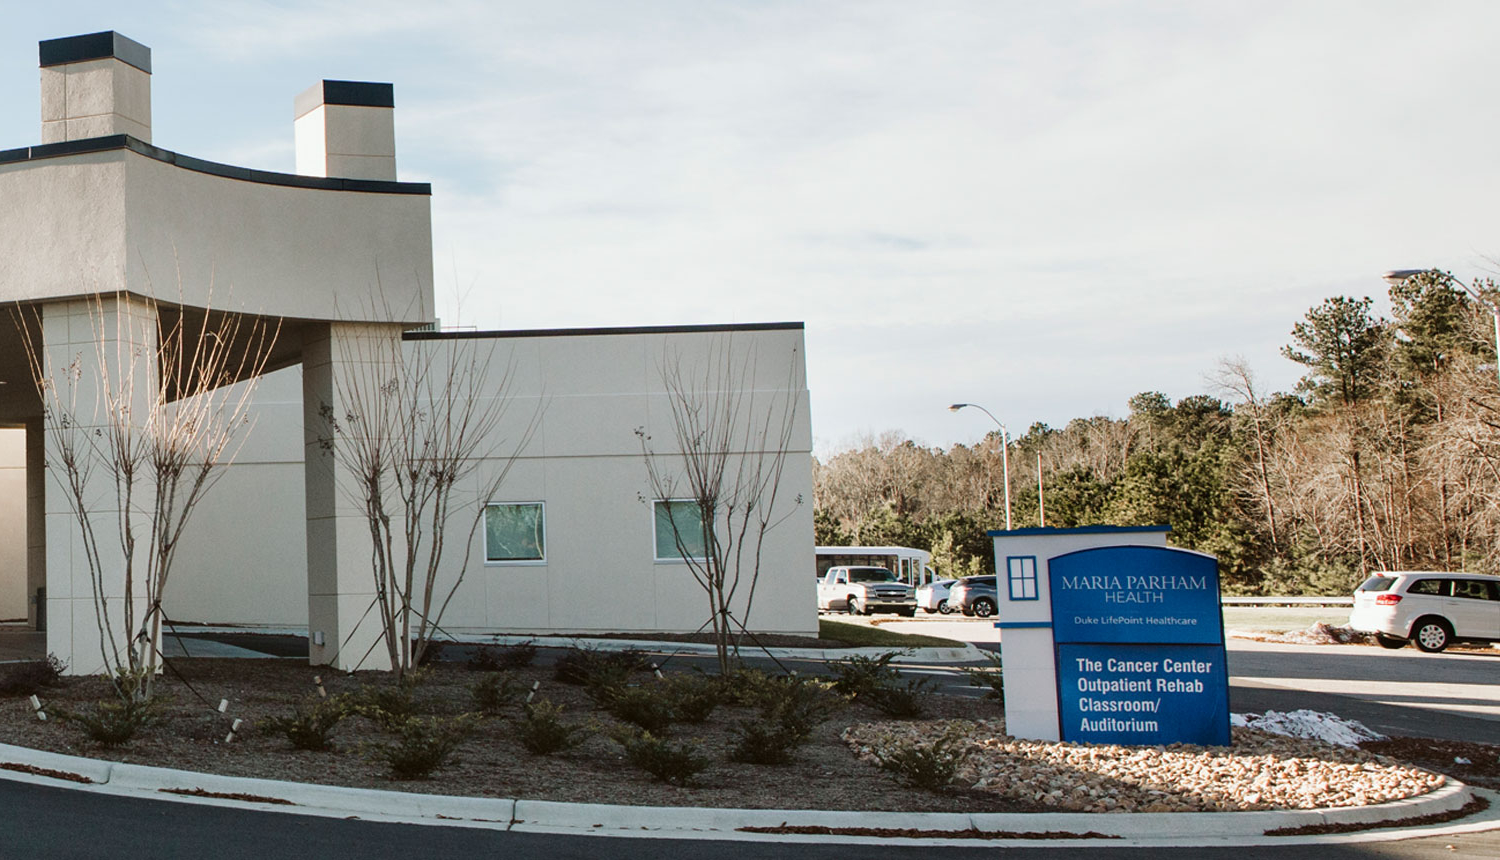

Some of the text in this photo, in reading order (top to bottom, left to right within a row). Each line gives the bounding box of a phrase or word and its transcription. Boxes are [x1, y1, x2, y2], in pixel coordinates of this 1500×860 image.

[1062, 575, 1207, 590] MARIA PARHAM
[1105, 591, 1164, 604] HEALTH
[1074, 616, 1197, 626] Duke LifePoint Healthcare
[1076, 658, 1212, 674] The Cancer Center
[1077, 677, 1204, 694] Outpatient Rehab
[1079, 697, 1162, 714] Classroom/
[1080, 717, 1158, 732] Auditorium
